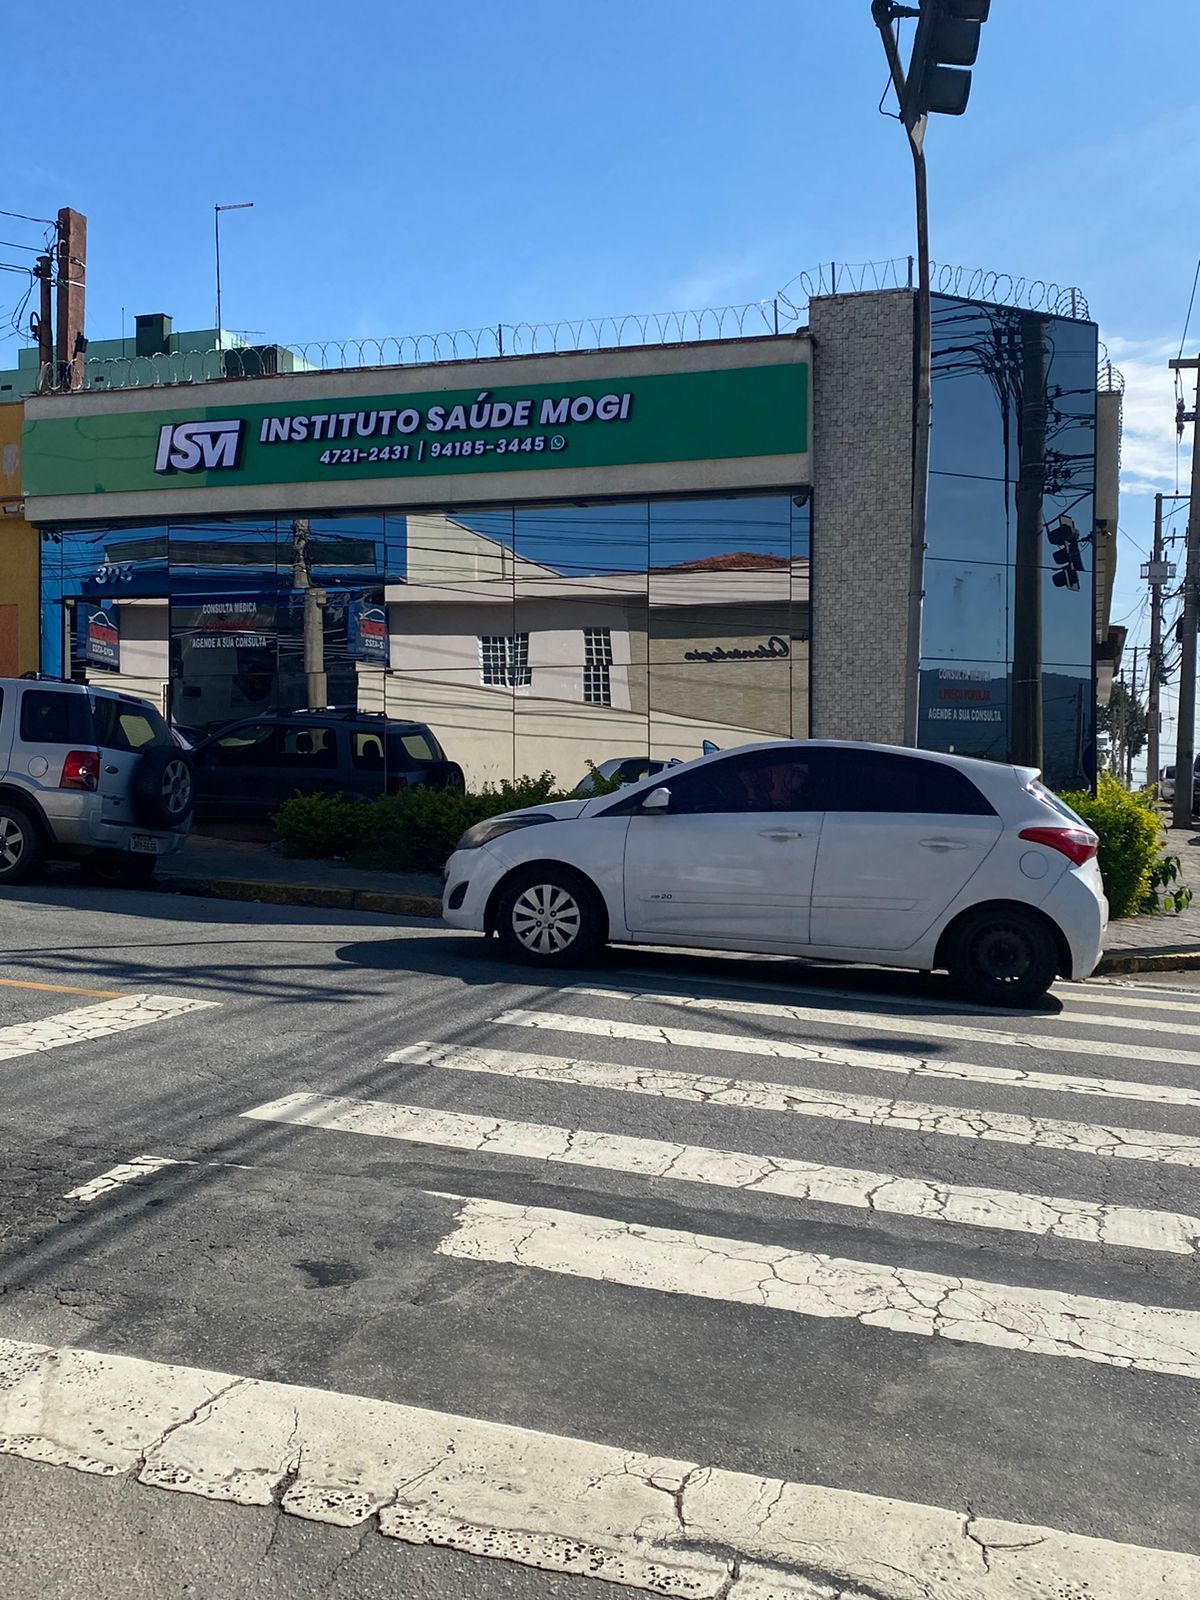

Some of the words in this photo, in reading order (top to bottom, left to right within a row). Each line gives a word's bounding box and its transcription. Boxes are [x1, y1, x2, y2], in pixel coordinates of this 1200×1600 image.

[259, 408, 420, 442] INSTITUTO
[426, 392, 532, 432] SAÚDE
[539, 393, 631, 424] MOGI
[155, 420, 242, 471] ISM
[319, 444, 409, 464] 4721-2431
[430, 437, 545, 458] 94185-3445
[202, 603, 233, 614] CONSULTA
[192, 638, 216, 648] AGENDE
[216, 638, 222, 648] A
[222, 637, 235, 648] SUA
[235, 636, 267, 648] CONSULTA
[938, 668, 970, 680] CONSULTA
[928, 707, 952, 719] AGENDE
[952, 708, 958, 720] A
[959, 709, 970, 720] SUA
[970, 709, 1002, 721] CONSULTA
